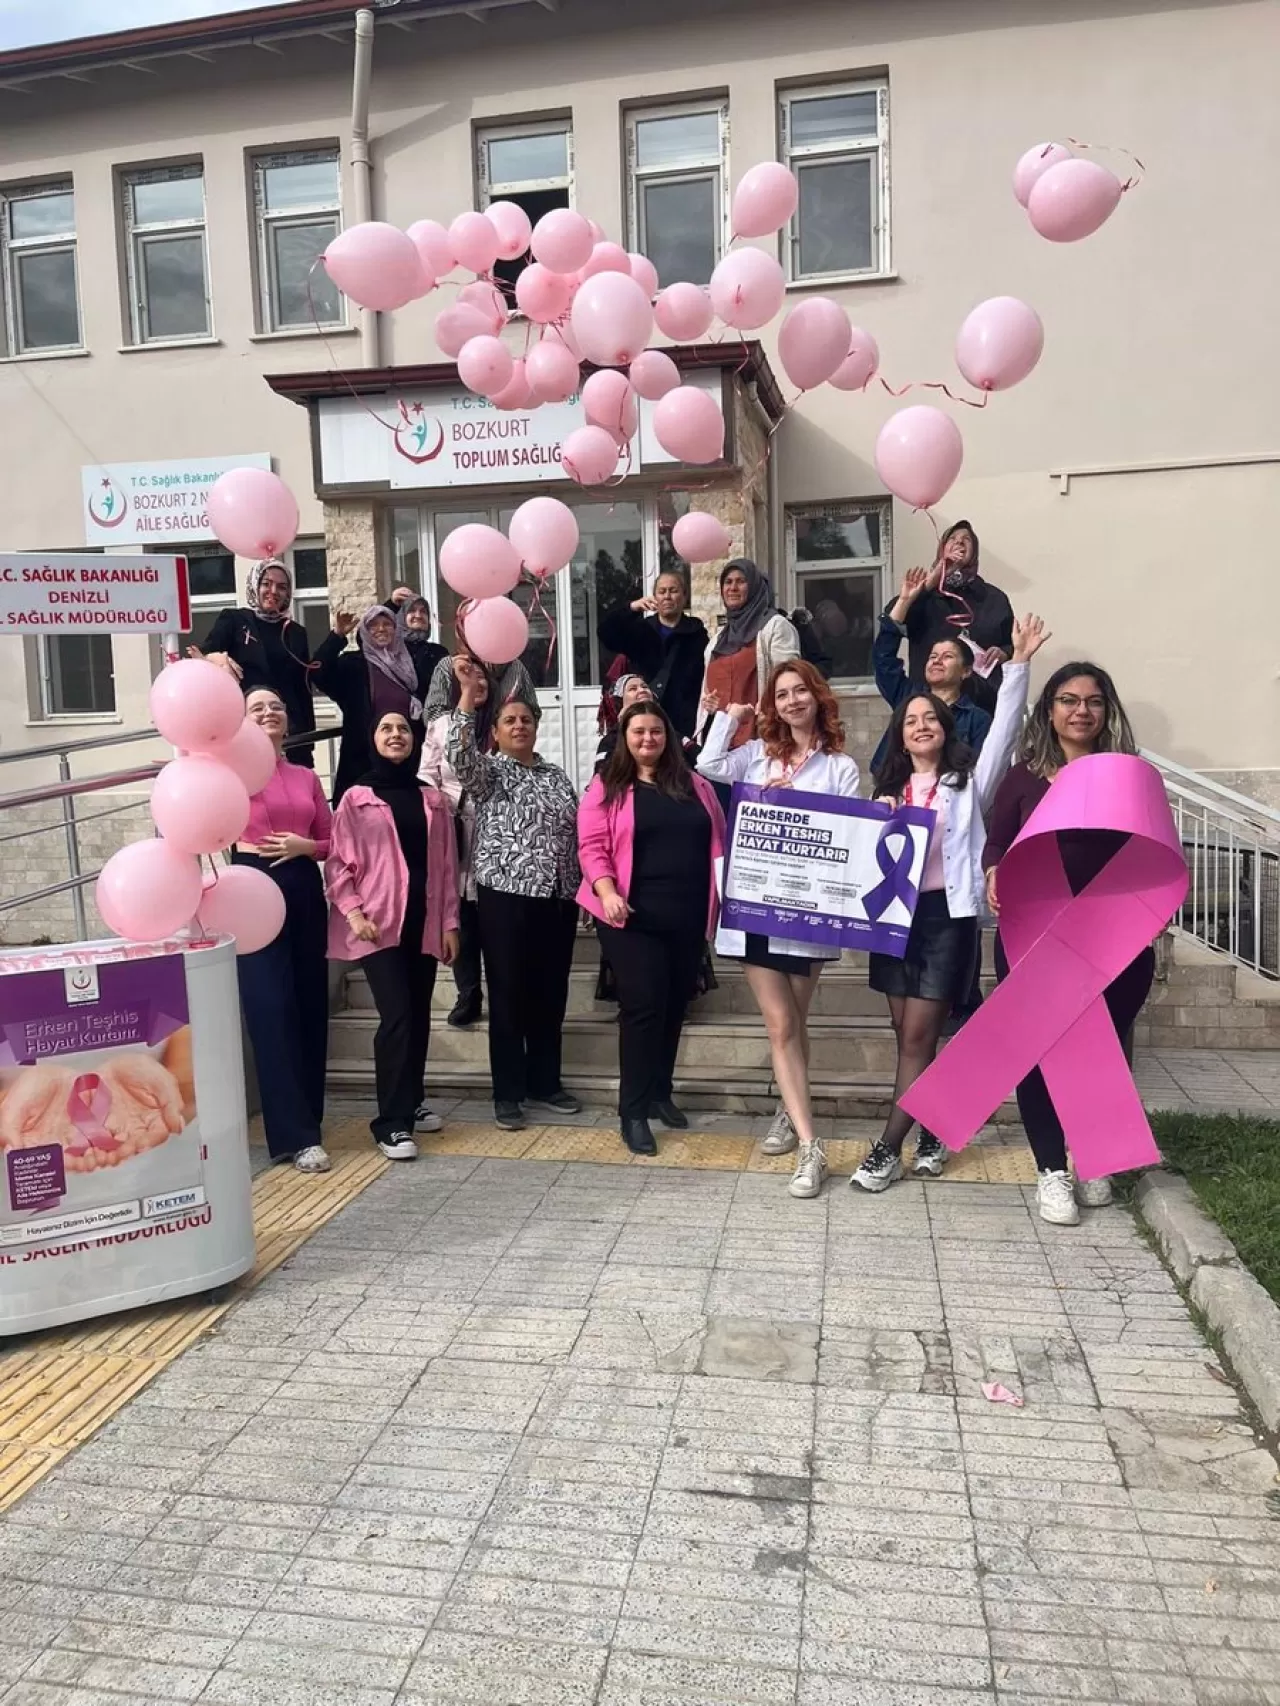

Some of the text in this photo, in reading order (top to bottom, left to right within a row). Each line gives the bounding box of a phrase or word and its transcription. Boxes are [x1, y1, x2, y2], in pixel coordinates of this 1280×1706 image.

[452, 418, 531, 441] BOZKURT
[453, 442, 562, 469] TOPLUM SAĞLIĞ
[151, 474, 181, 488] Sağlık
[133, 492, 187, 510] BOZKURT
[191, 491, 197, 506] 2
[136, 510, 210, 532] AİLE SAĞLIĞ
[22, 565, 75, 583] SAĞLIK
[80, 566, 159, 583] BAKANLIĞI
[48, 589, 110, 604] DENİZLİ
[7, 609, 168, 625] SAĞLIK MÜDÜRLÜĞÜ
[741, 805, 811, 825] KANSERDE
[740, 819, 782, 836] ERKEN
[738, 834, 780, 852] HAYAT
[781, 842, 848, 863] KURTARIR
[25, 1010, 139, 1039] Erken Teşhis
[26, 1037, 76, 1055] Hayat
[156, 1193, 196, 1209] KETEM
